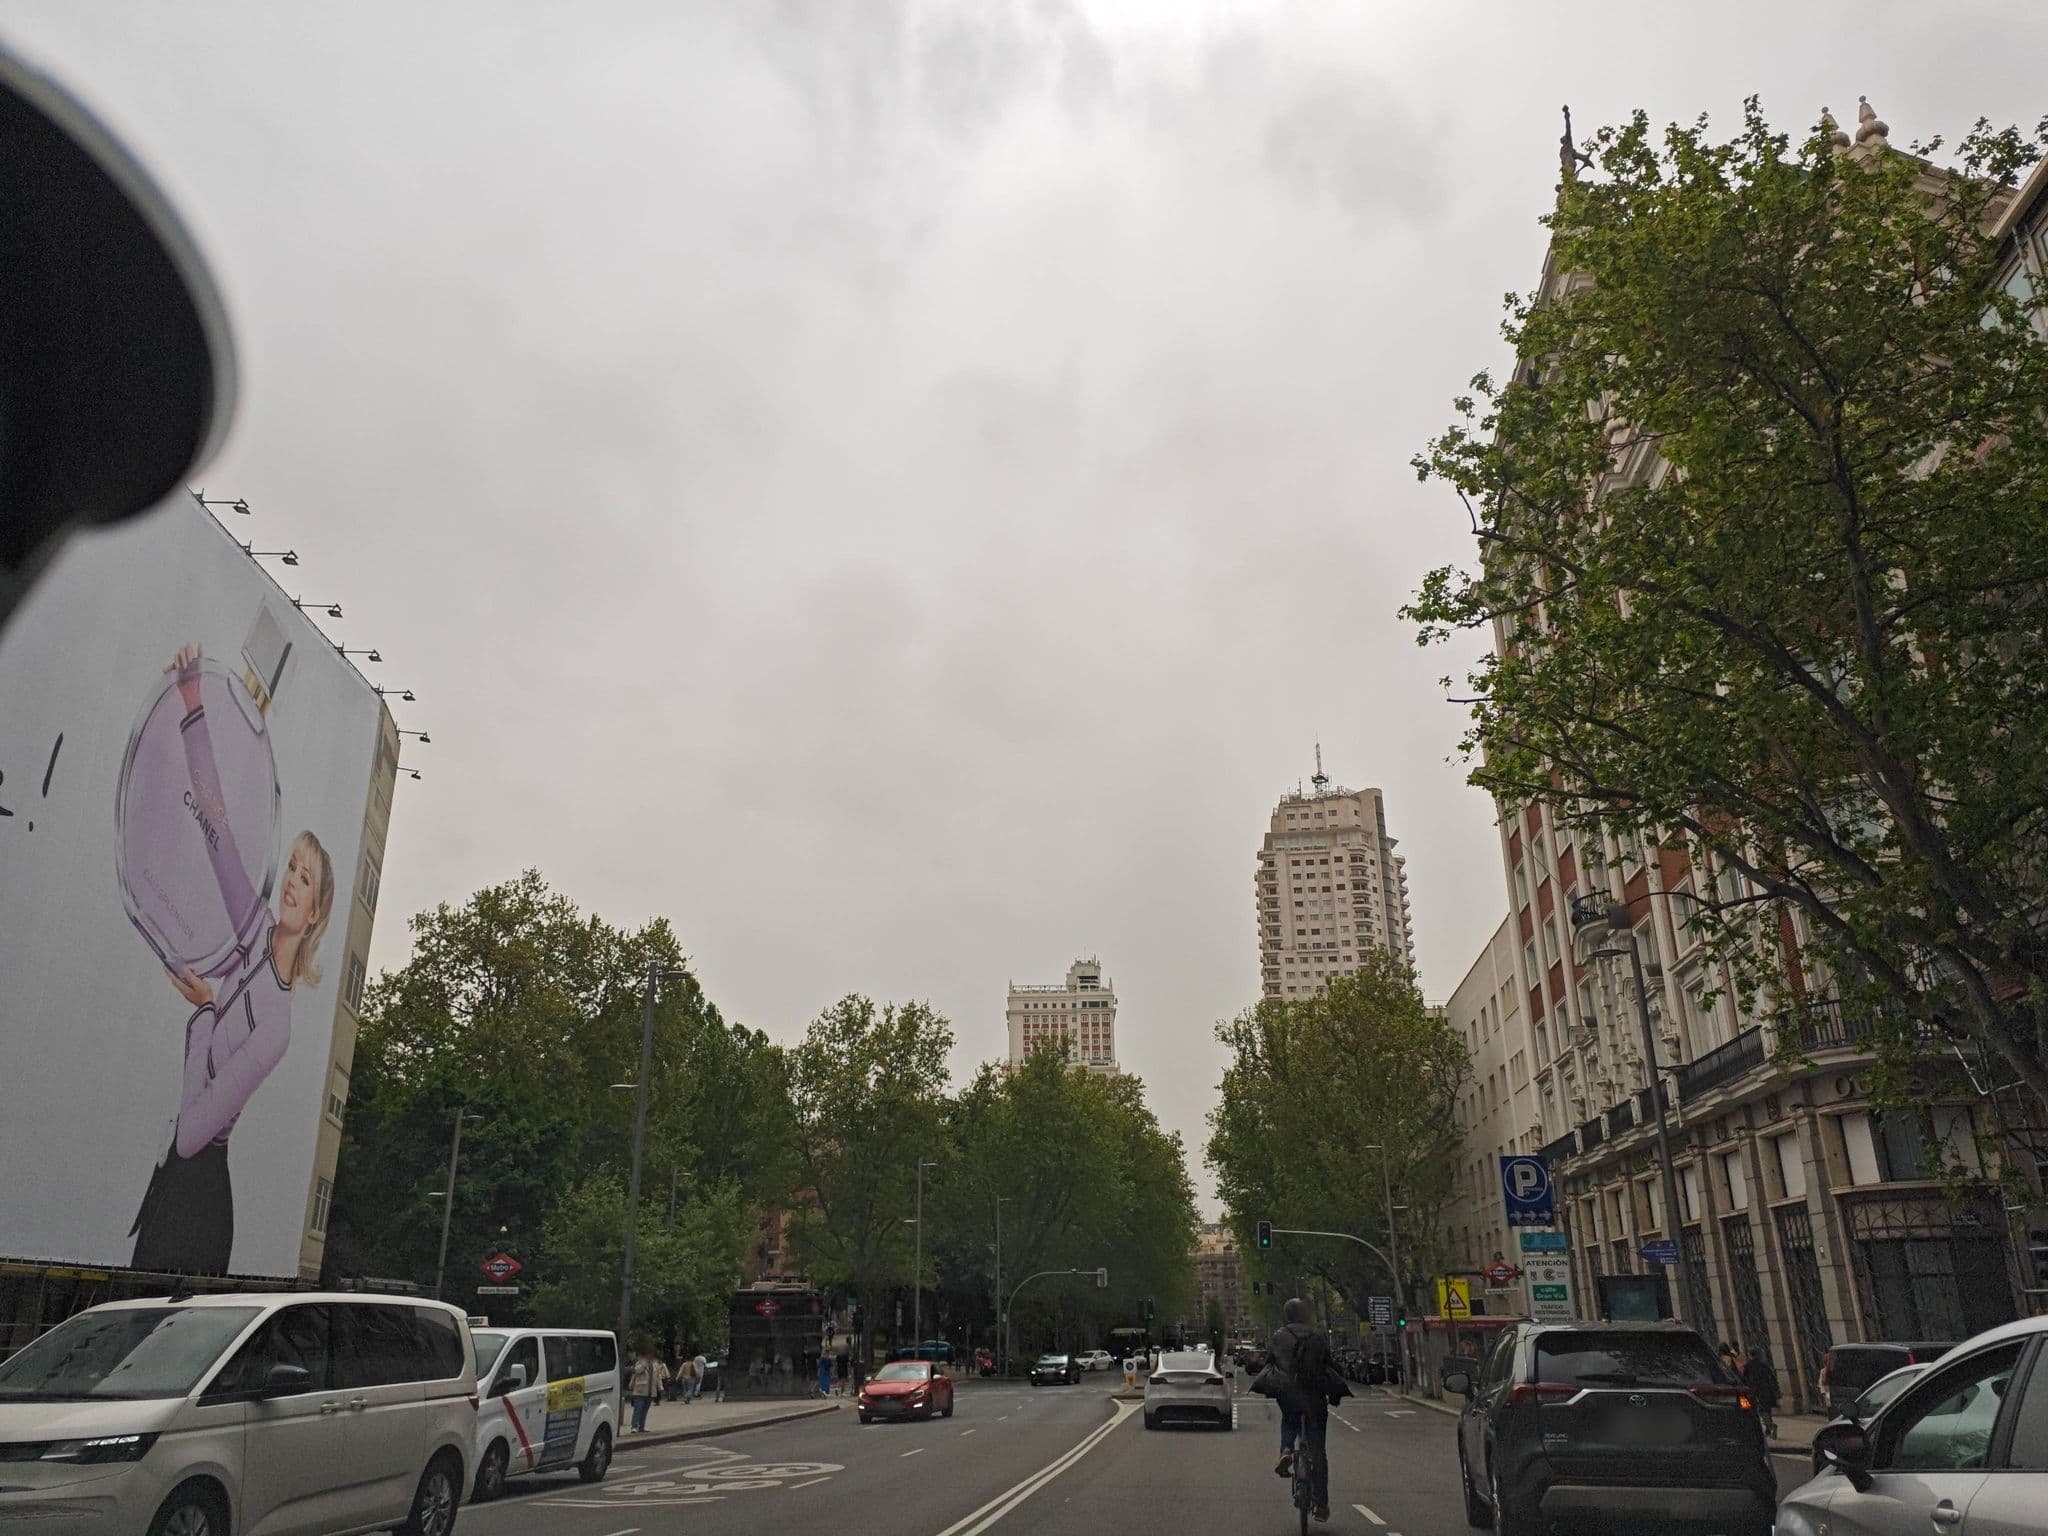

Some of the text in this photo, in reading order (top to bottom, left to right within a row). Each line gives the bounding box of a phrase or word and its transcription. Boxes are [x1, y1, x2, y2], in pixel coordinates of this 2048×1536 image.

[183, 790, 221, 853] CHANEL
[1513, 1164, 1538, 1197] P
[490, 1264, 509, 1272] Metro
